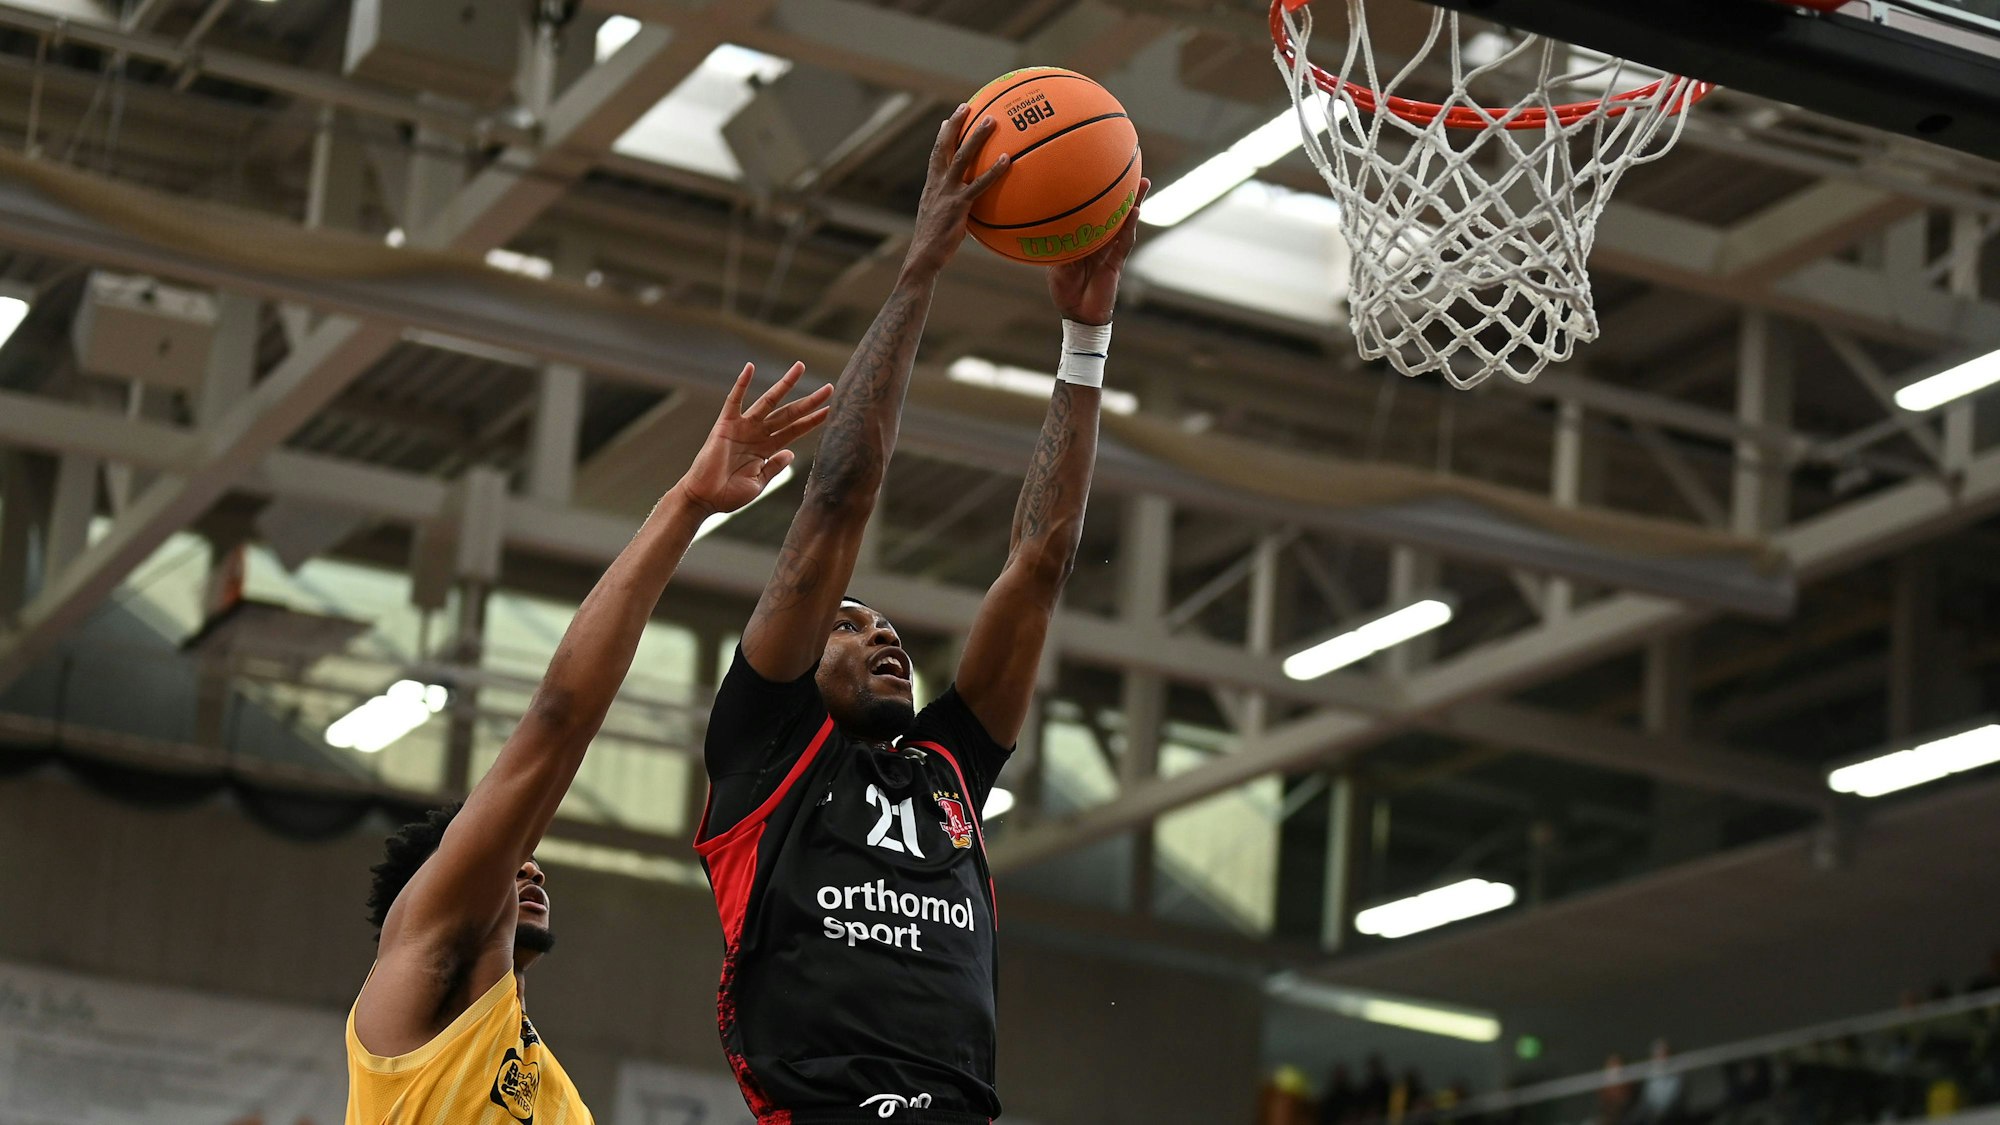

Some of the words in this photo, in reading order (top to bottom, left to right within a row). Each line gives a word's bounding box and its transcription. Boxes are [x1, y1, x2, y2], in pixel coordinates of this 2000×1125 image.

[1007, 93, 1046, 116] APPROVED
[1011, 100, 1055, 132] FIBA
[1016, 190, 1136, 257] Wilson
[865, 784, 925, 859] 21
[817, 879, 975, 932] orthomol
[823, 916, 923, 952] sport
